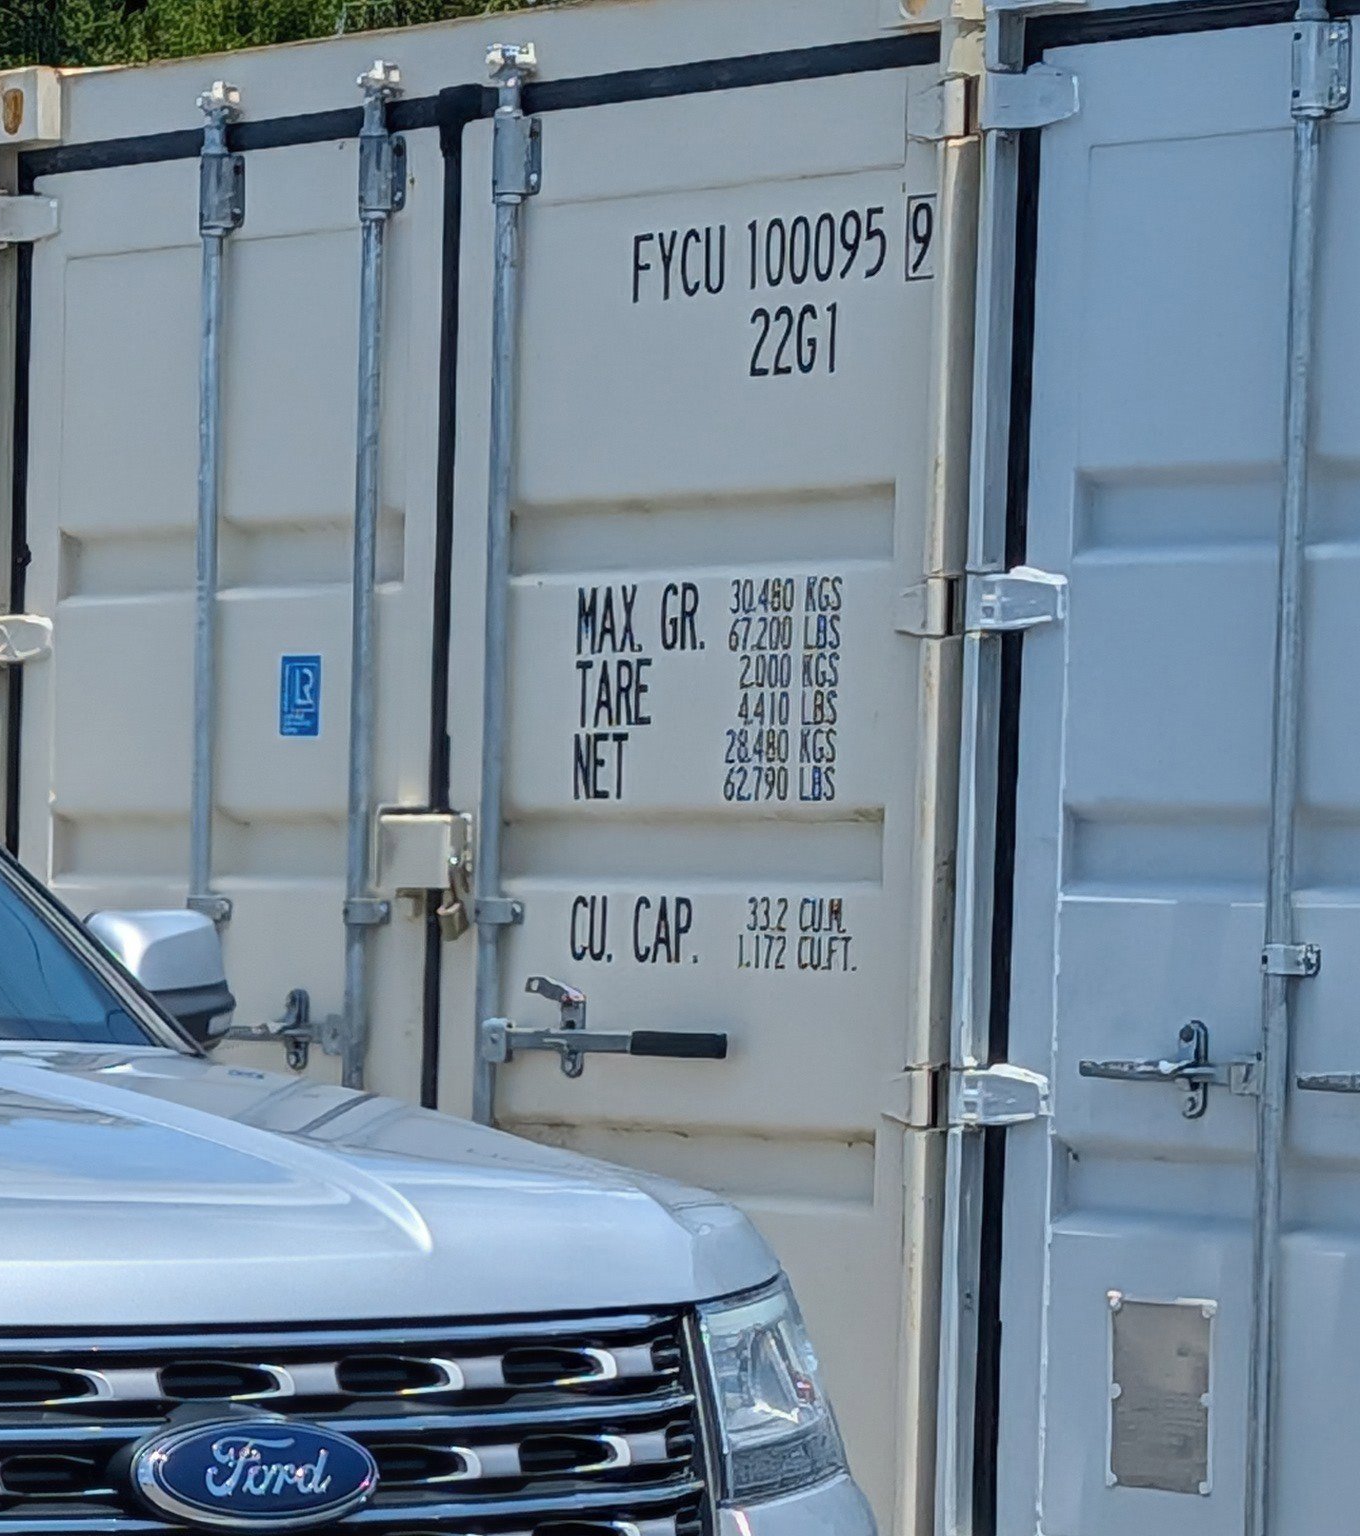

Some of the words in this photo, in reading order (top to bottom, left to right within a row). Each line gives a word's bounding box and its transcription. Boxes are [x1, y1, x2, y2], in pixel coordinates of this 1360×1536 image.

[632, 224, 726, 304] FYCU
[747, 206, 887, 290] 100095
[911, 202, 934, 274] 9
[749, 301, 837, 377] 22G1
[805, 575, 843, 612] KGS
[576, 584, 643, 655] MAX.
[661, 582, 705, 652] GR.
[803, 613, 841, 650] LBS
[576, 658, 653, 728] TARE
[801, 651, 840, 687] KGS
[801, 689, 838, 726] LBS
[574, 732, 629, 800] NET
[799, 728, 837, 763] KGS
[799, 765, 836, 801] LBS
[570, 895, 613, 963] CU.
[633, 895, 698, 964] CAP.
[746, 896, 789, 932] 33.2
[205, 1436, 331, 1497] Ford
